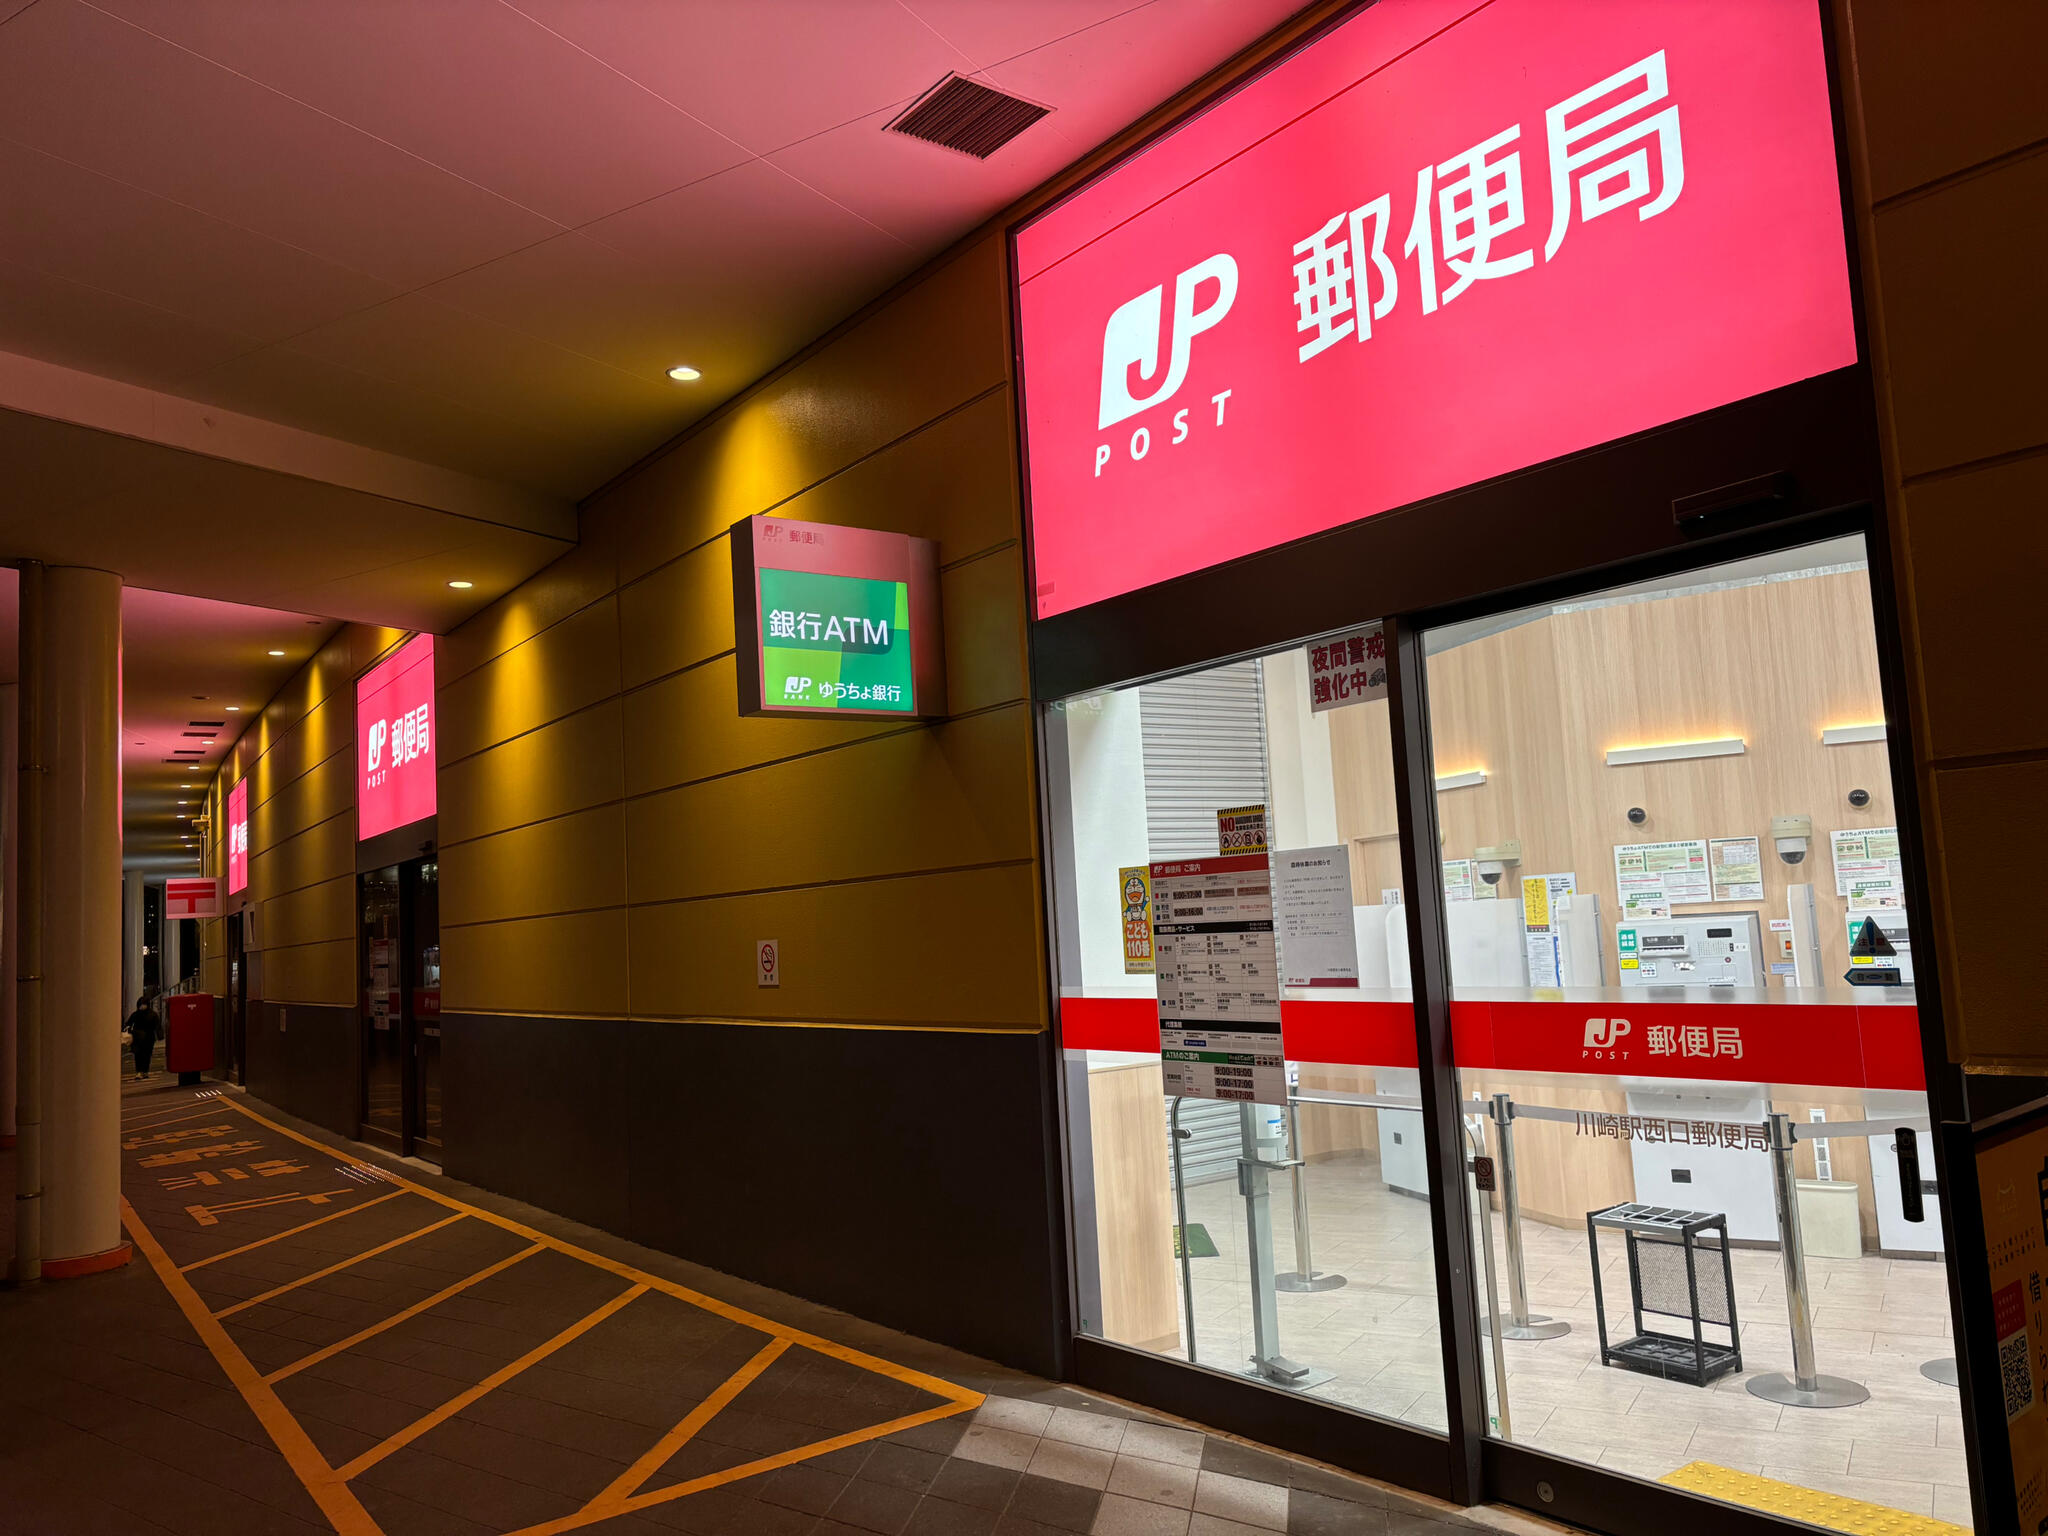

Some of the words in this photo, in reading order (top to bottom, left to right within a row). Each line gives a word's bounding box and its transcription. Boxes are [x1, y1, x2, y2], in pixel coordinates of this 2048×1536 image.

[1098, 253, 1240, 430] JP
[1292, 48, 1685, 364] 郵便局
[1094, 390, 1232, 478] POST
[789, 530, 825, 545] 郵便局
[769, 609, 888, 645] 銀行ATM
[1311, 631, 1386, 674] 夜間警戒
[784, 676, 812, 694] JP
[818, 681, 901, 701] ゆうちょ銀行
[1313, 667, 1368, 705] 強化中
[367, 718, 387, 772] JP
[391, 703, 430, 769] 郵便局
[367, 769, 386, 789] POST
[1220, 817, 1235, 833] NO
[1126, 922, 1149, 939] こども
[1127, 941, 1151, 957] 110番
[1583, 1018, 1631, 1048] JP
[1647, 1025, 1743, 1059] 郵便局
[1165, 1051, 1200, 1061] ATMのご案内
[1582, 1051, 1629, 1060] POST
[1214, 1066, 1253, 1077] 9:00-19:00
[1215, 1077, 1254, 1089] 9:00-17:00
[1216, 1088, 1255, 1100] 9:00-17:00
[1575, 1111, 1770, 1153] 川崎駅西口郵便局
